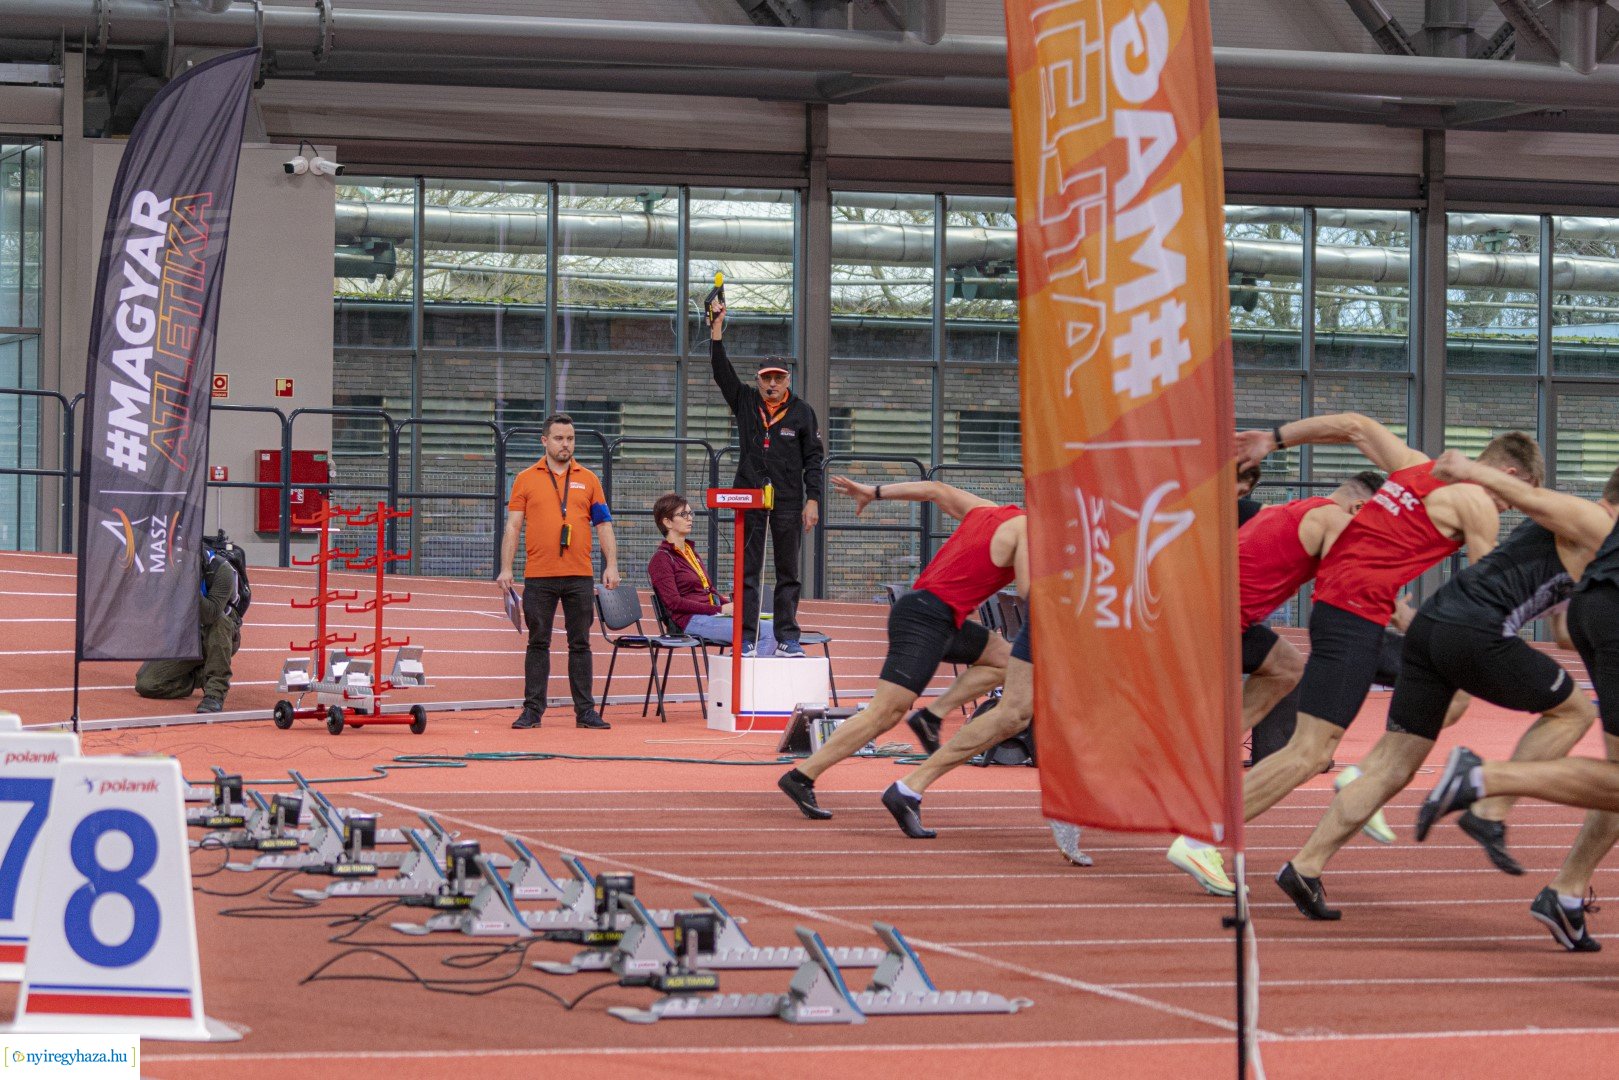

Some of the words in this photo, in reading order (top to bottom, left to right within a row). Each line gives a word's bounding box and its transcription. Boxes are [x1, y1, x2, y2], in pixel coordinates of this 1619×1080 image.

[106, 190, 172, 473] #MAGYAR
[150, 192, 213, 472] ATLETIKA
[149, 514, 168, 573] MASZ
[727, 494, 751, 502] polanik
[5, 750, 60, 766] polanik
[100, 777, 160, 794] polanik
[0, 777, 54, 921] 7
[64, 808, 161, 969] 8
